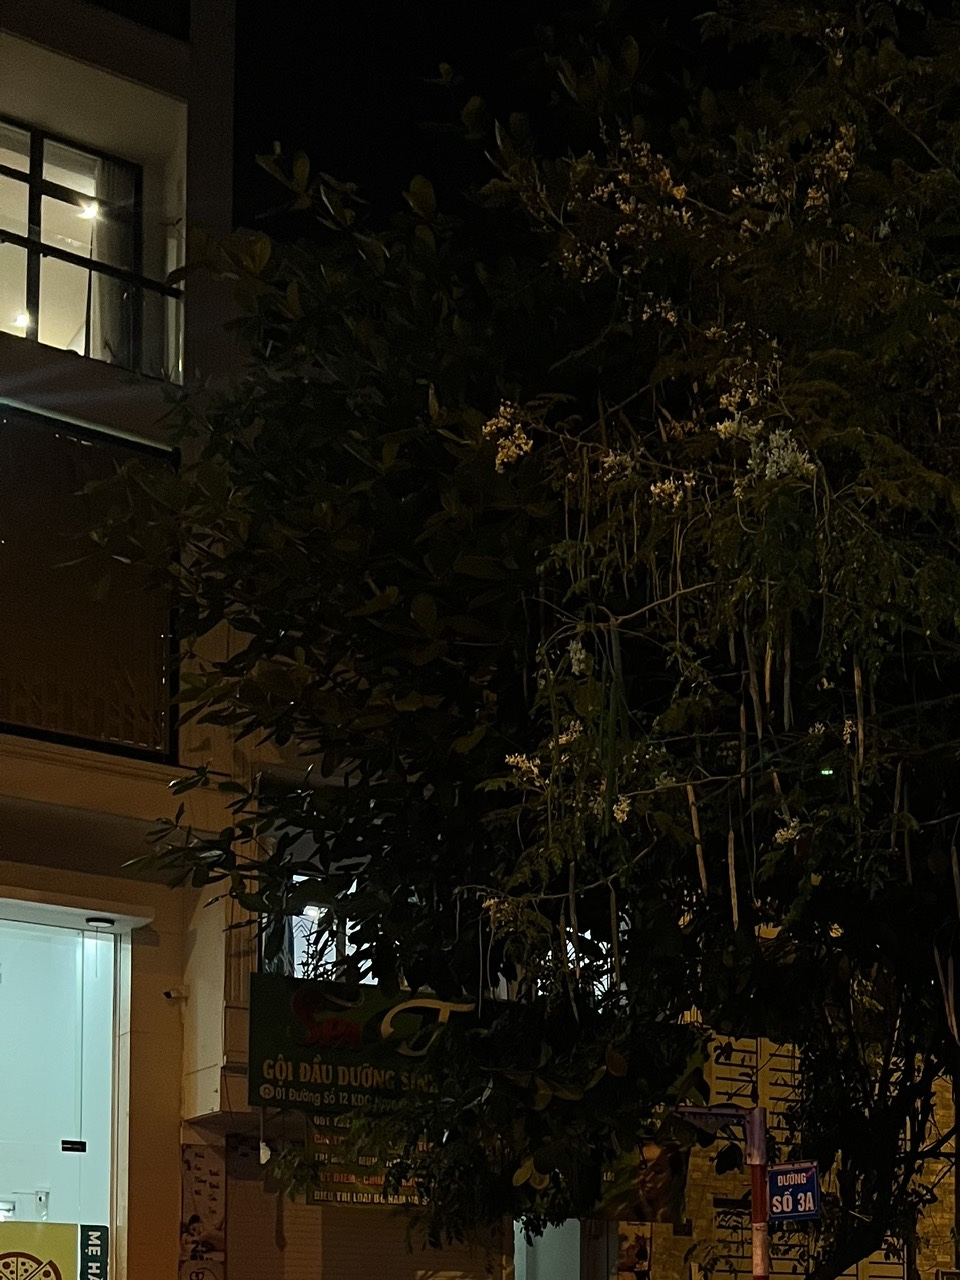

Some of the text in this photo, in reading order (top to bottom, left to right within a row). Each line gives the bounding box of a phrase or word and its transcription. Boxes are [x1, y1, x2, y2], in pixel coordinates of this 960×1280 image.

[262, 1054, 294, 1085] GỘI
[299, 1054, 333, 1085] ĐẦU
[337, 1063, 396, 1090] DƯỠNG
[288, 1088, 321, 1107] Đường
[339, 1091, 349, 1104] 12
[772, 1188, 815, 1213] SỐ 3A
[85, 1231, 101, 1256] MẸ
